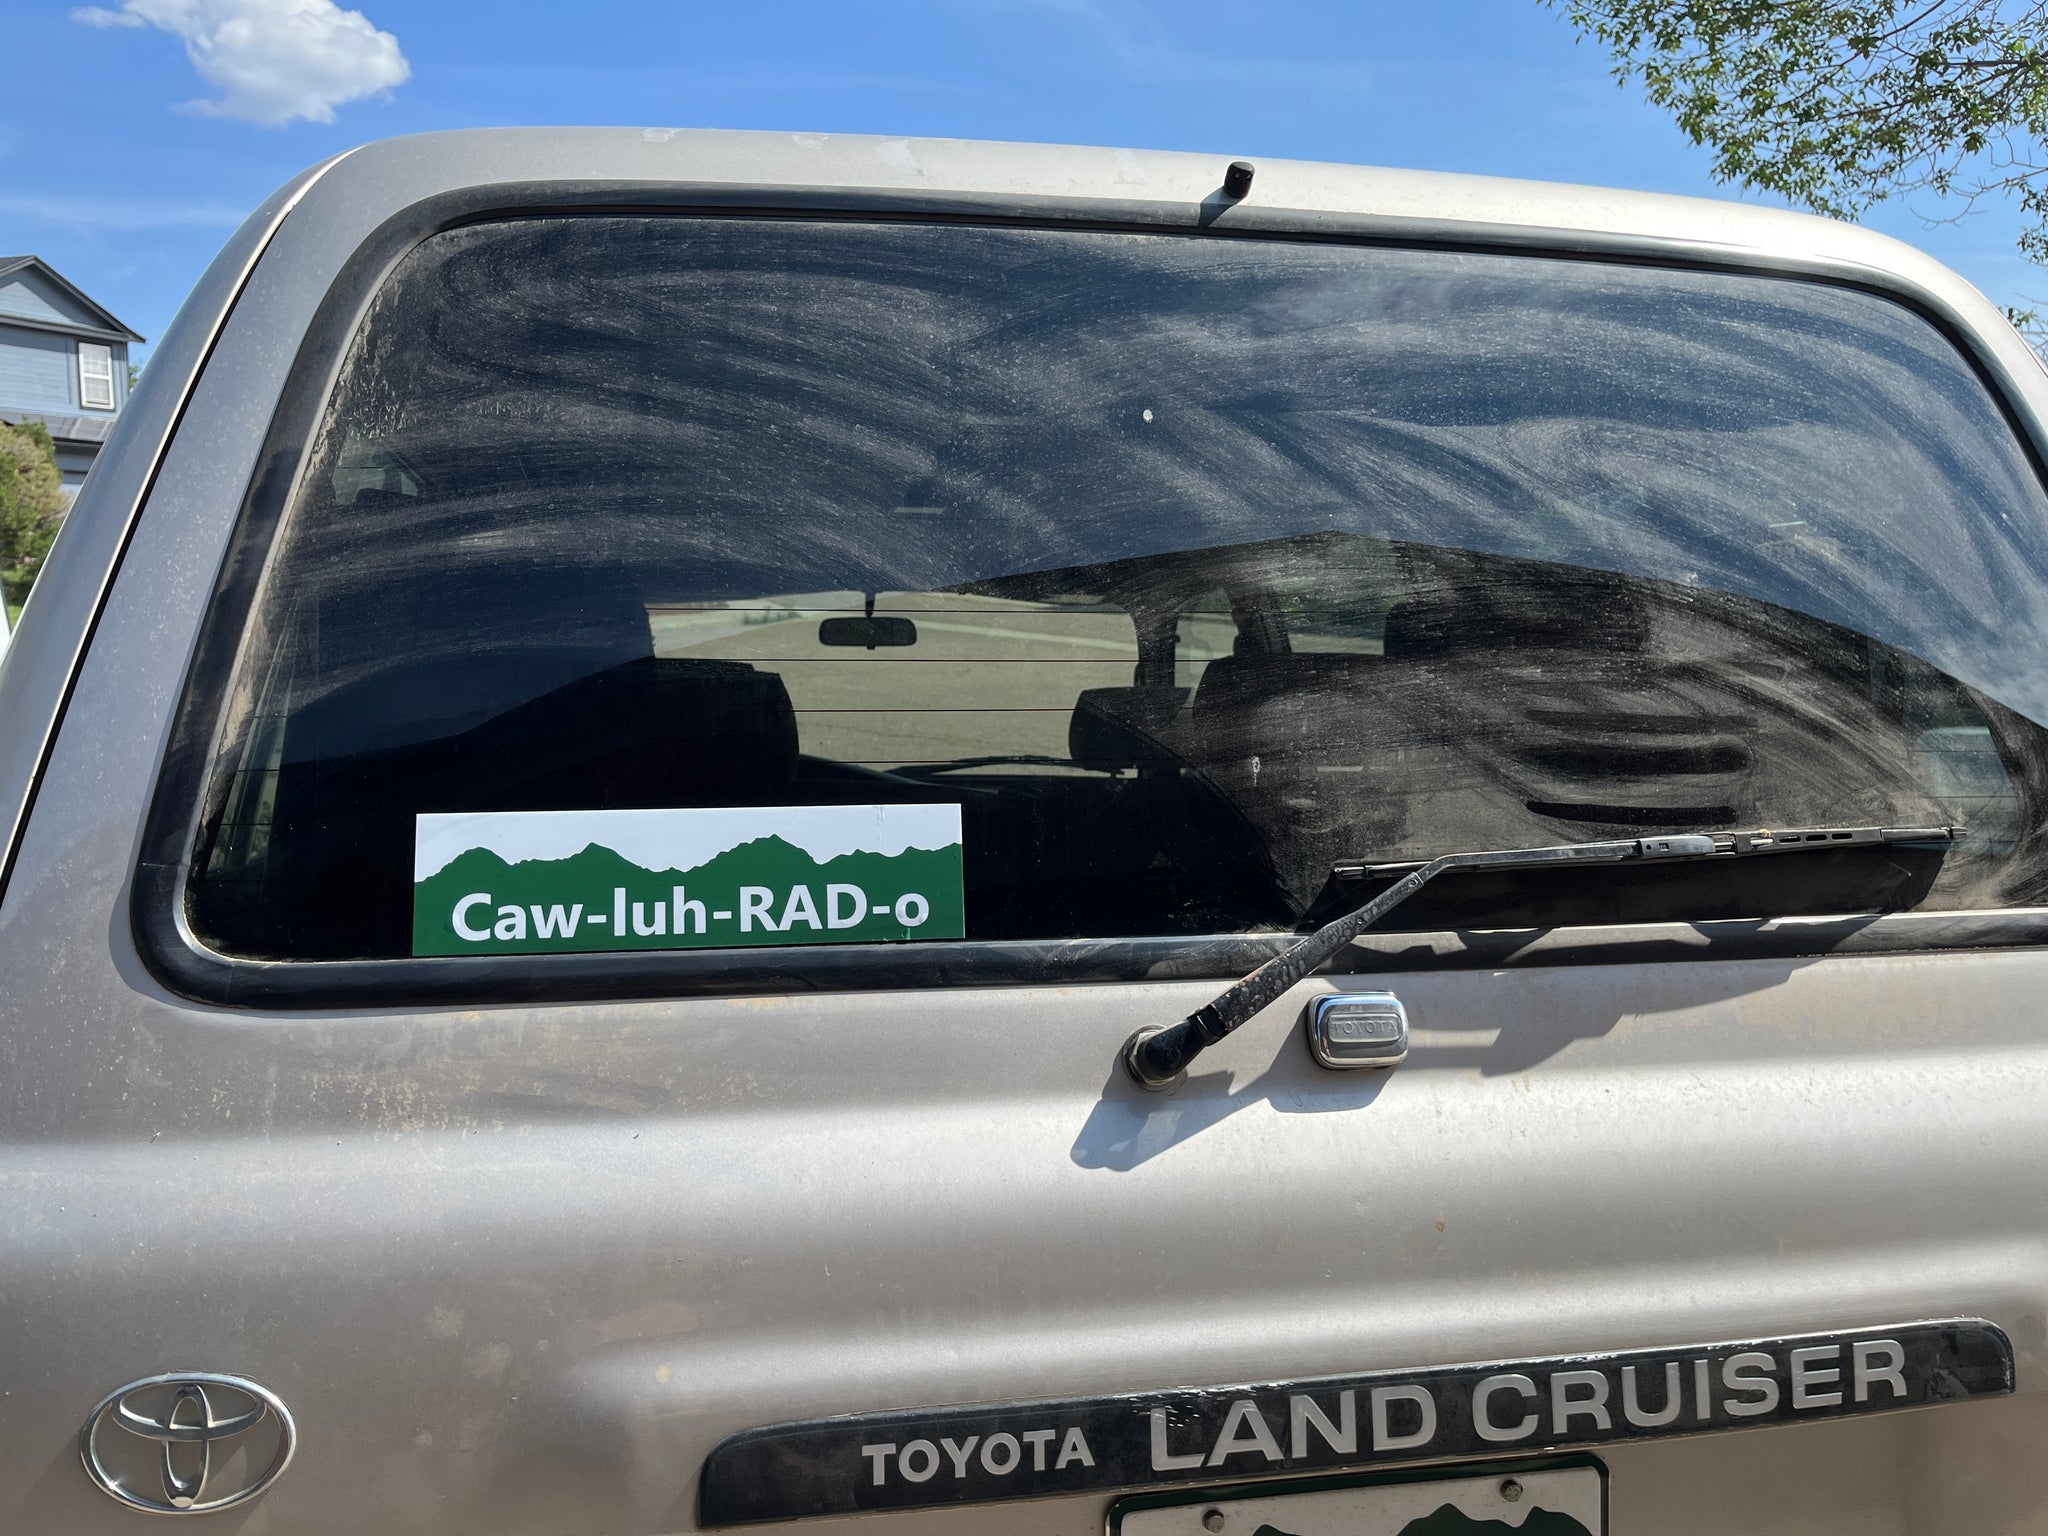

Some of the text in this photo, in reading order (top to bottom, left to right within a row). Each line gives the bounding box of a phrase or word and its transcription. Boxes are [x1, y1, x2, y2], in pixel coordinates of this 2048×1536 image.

[451, 883, 930, 941] Caw-luh-RAD-o
[1331, 1020, 1399, 1035] TOYOTA
[862, 1338, 1908, 1487] TOYOTA LAND CRUISER
